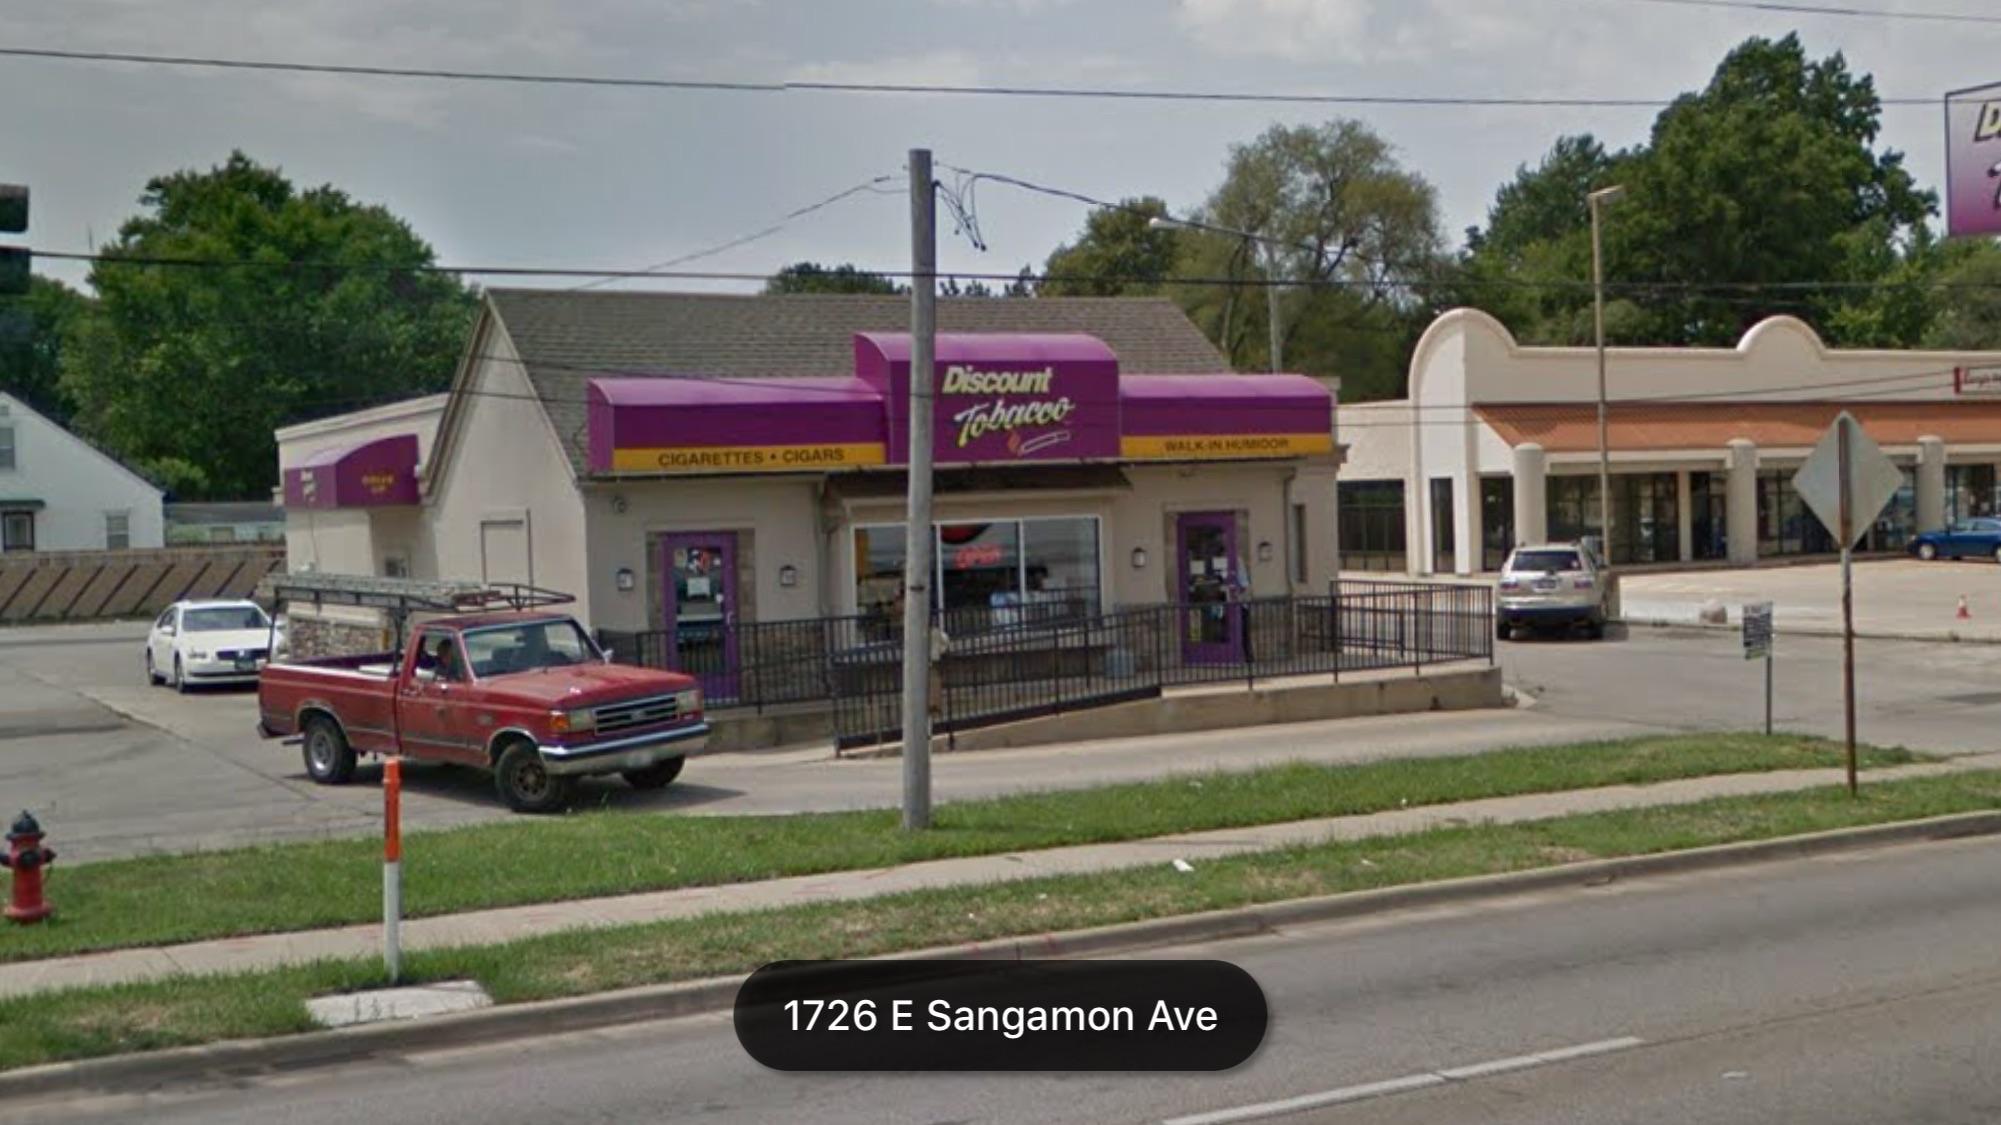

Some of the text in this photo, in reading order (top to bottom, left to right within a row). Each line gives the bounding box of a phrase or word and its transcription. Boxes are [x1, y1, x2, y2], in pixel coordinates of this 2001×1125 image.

[942, 365, 1053, 394] Discount
[953, 396, 1076, 448] Tobacco
[1165, 437, 1289, 452] WALK-IN HUMIDOR
[658, 447, 845, 467] CIGARETTES CIGARS
